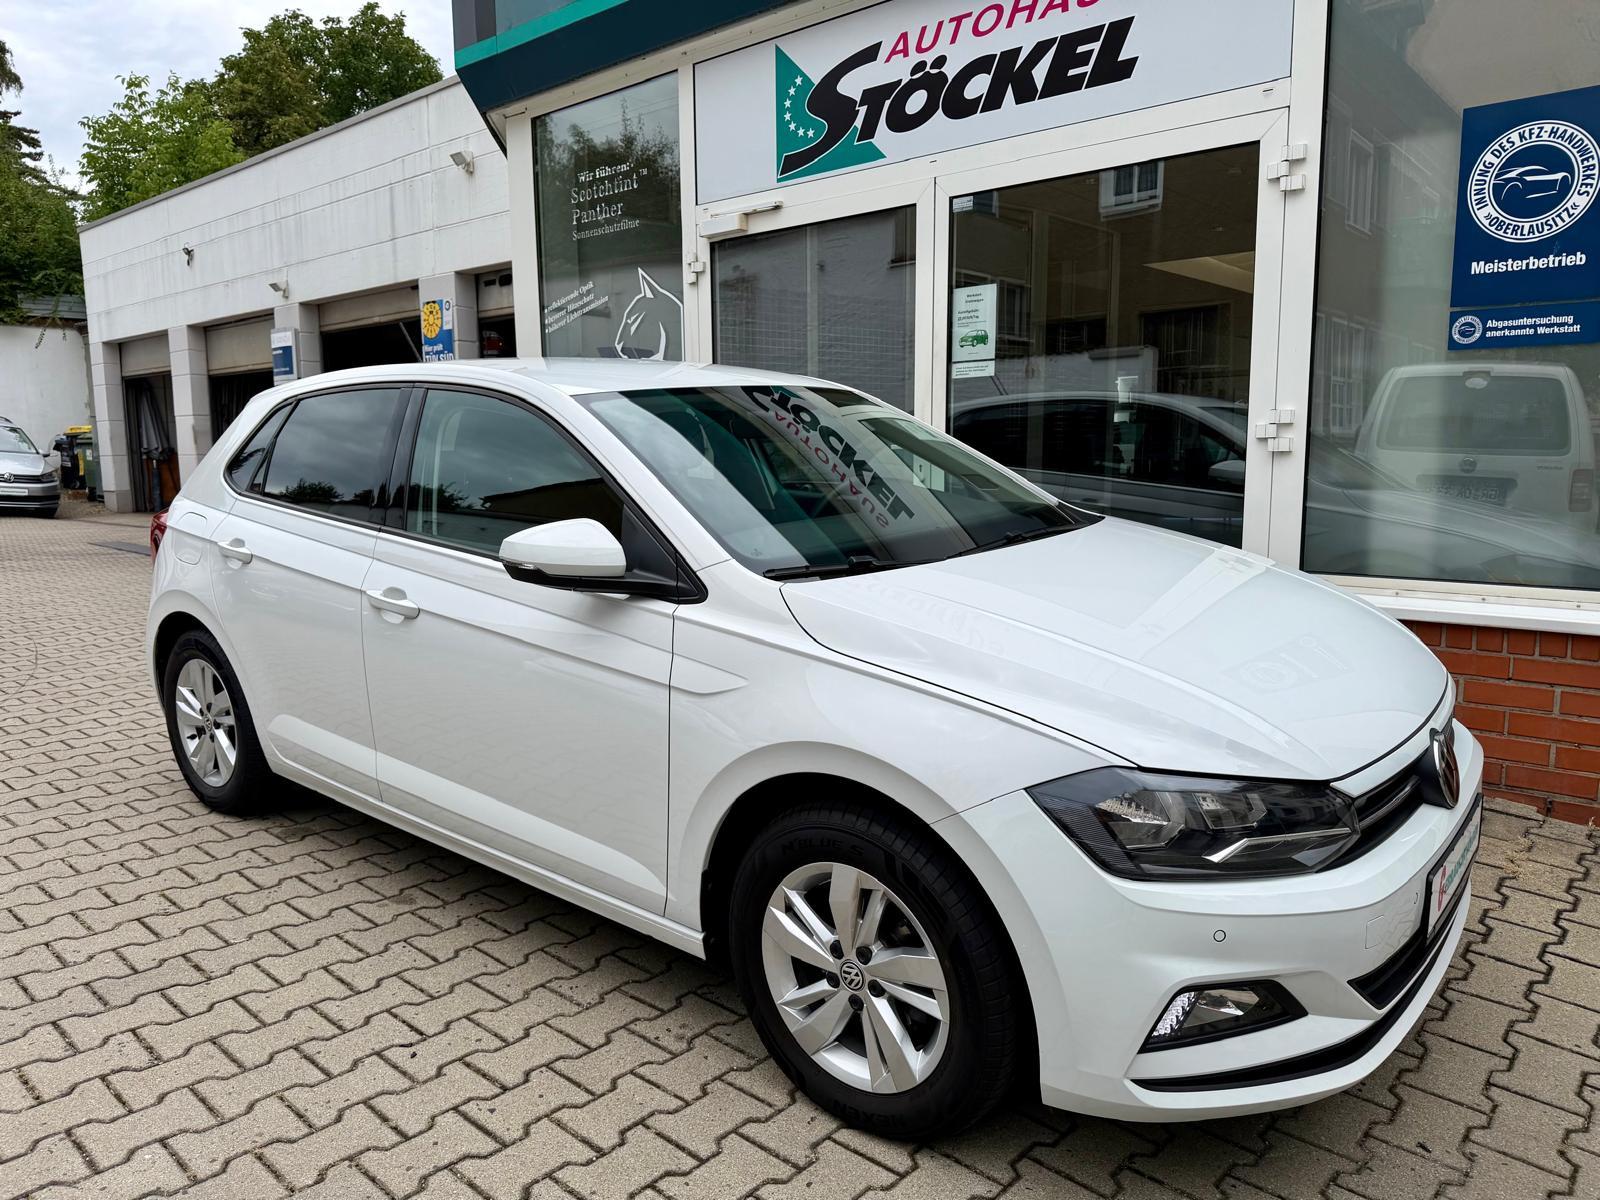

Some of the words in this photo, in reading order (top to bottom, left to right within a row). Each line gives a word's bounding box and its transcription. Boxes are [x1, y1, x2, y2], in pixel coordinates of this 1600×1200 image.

[885, 0, 1099, 63] AUTOHA
[778, 16, 1139, 177] STÖCKEL
[577, 170, 594, 183] Wir
[1474, 159, 1495, 211] INNUNG
[1490, 135, 1516, 160] DES
[1518, 126, 1597, 198] KFZ-HANDWERKES
[571, 203, 624, 225] Panther
[1470, 251, 1587, 275] Meisterbetrieb
[1485, 327, 1535, 338] anerkannte
[1537, 324, 1581, 335] Werkstatt
[1486, 315, 1574, 329] Abgasuntersuchung
